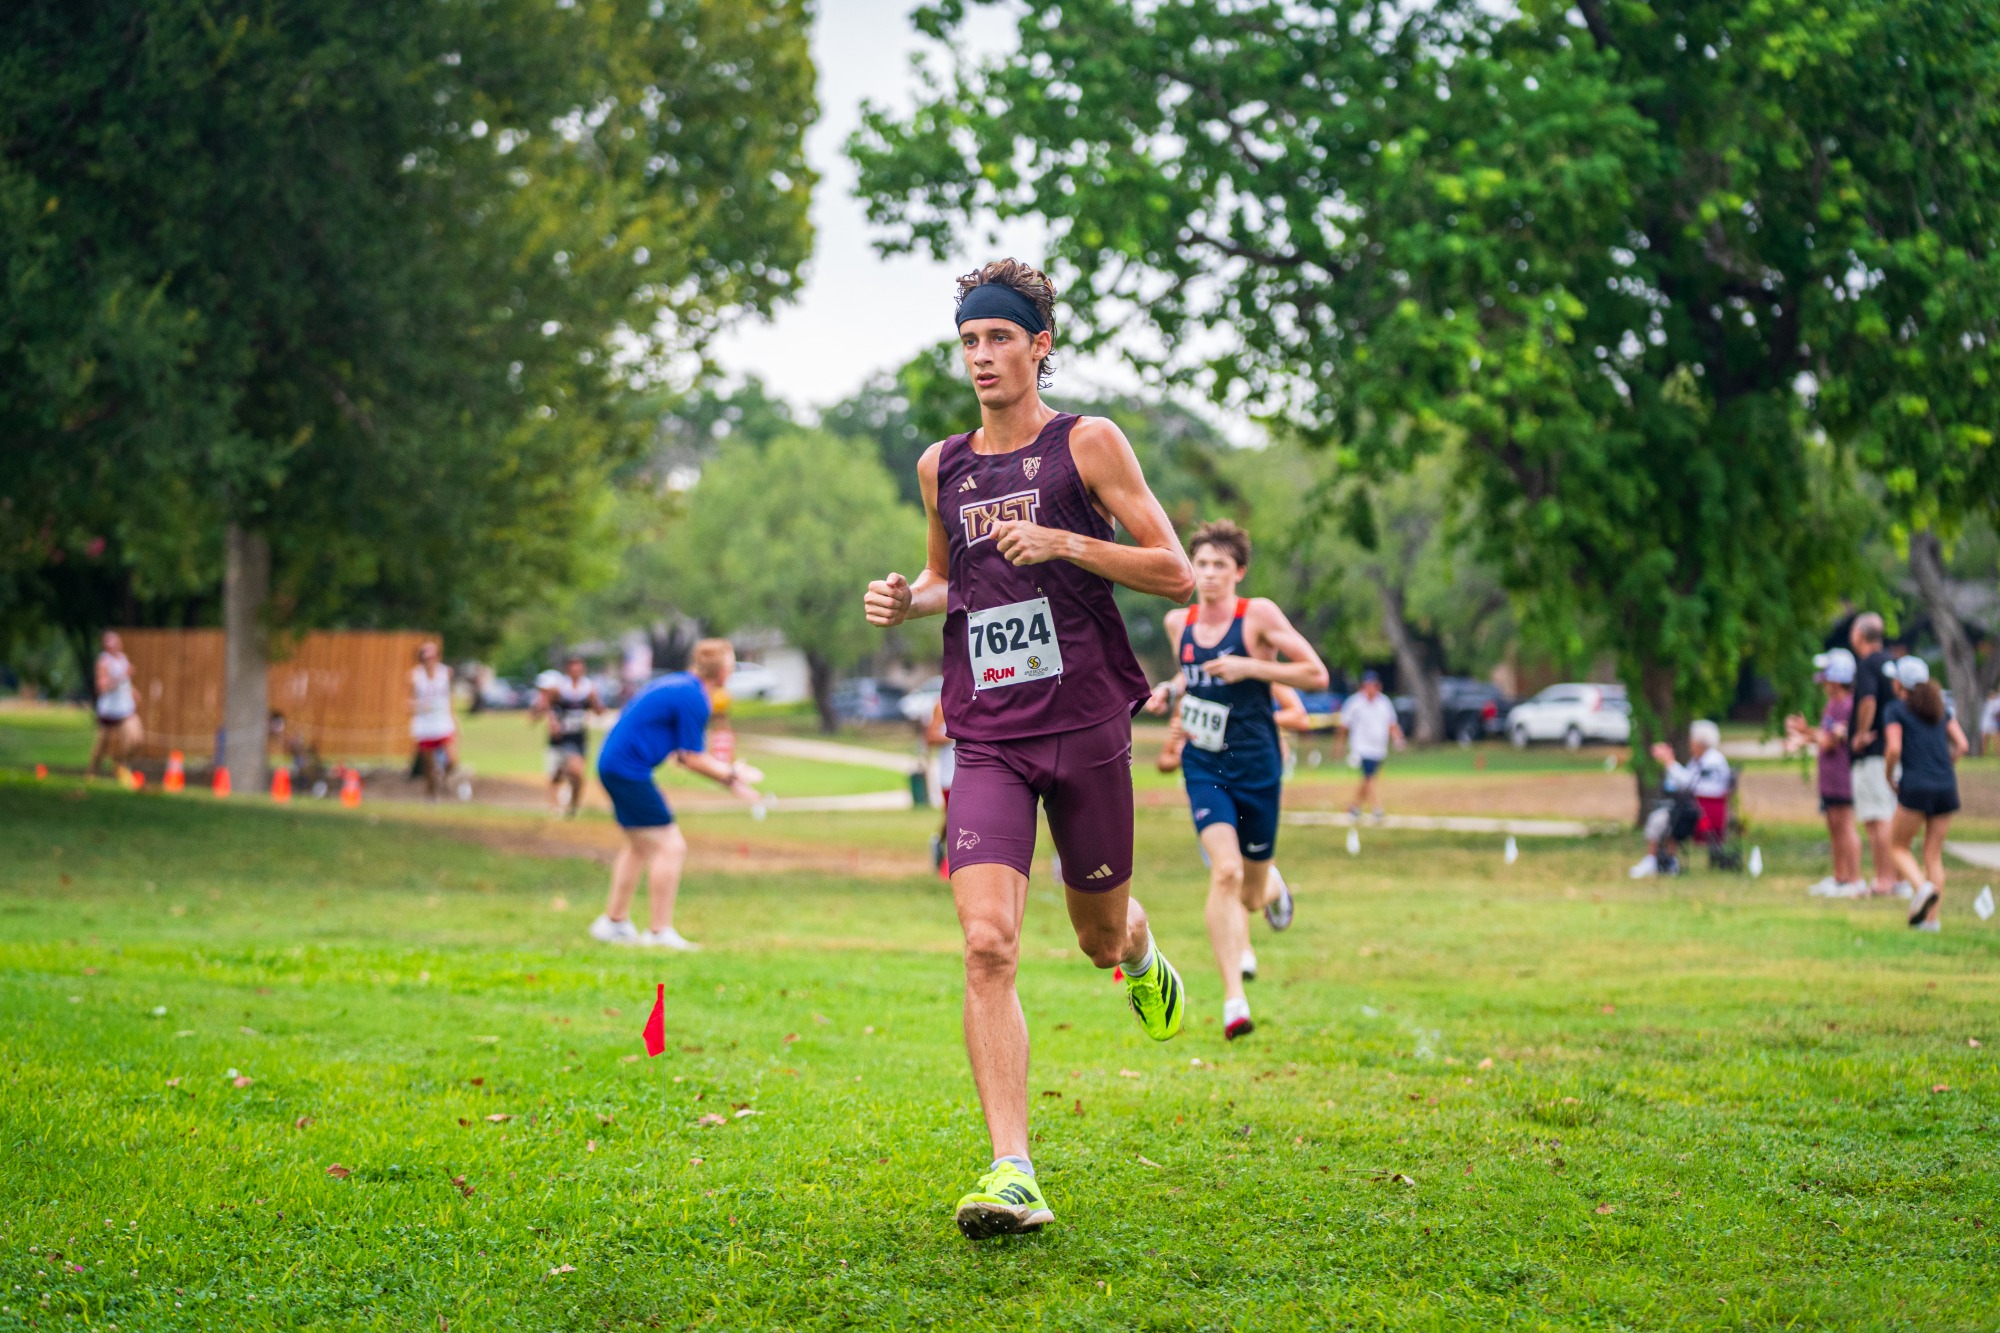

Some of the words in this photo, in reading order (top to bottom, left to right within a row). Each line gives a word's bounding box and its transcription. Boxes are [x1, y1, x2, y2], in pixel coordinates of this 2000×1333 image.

[962, 492, 1037, 543] TXST
[970, 612, 1051, 658] 7624
[983, 666, 1015, 683] iRUN
[1184, 704, 1222, 731] 7719
